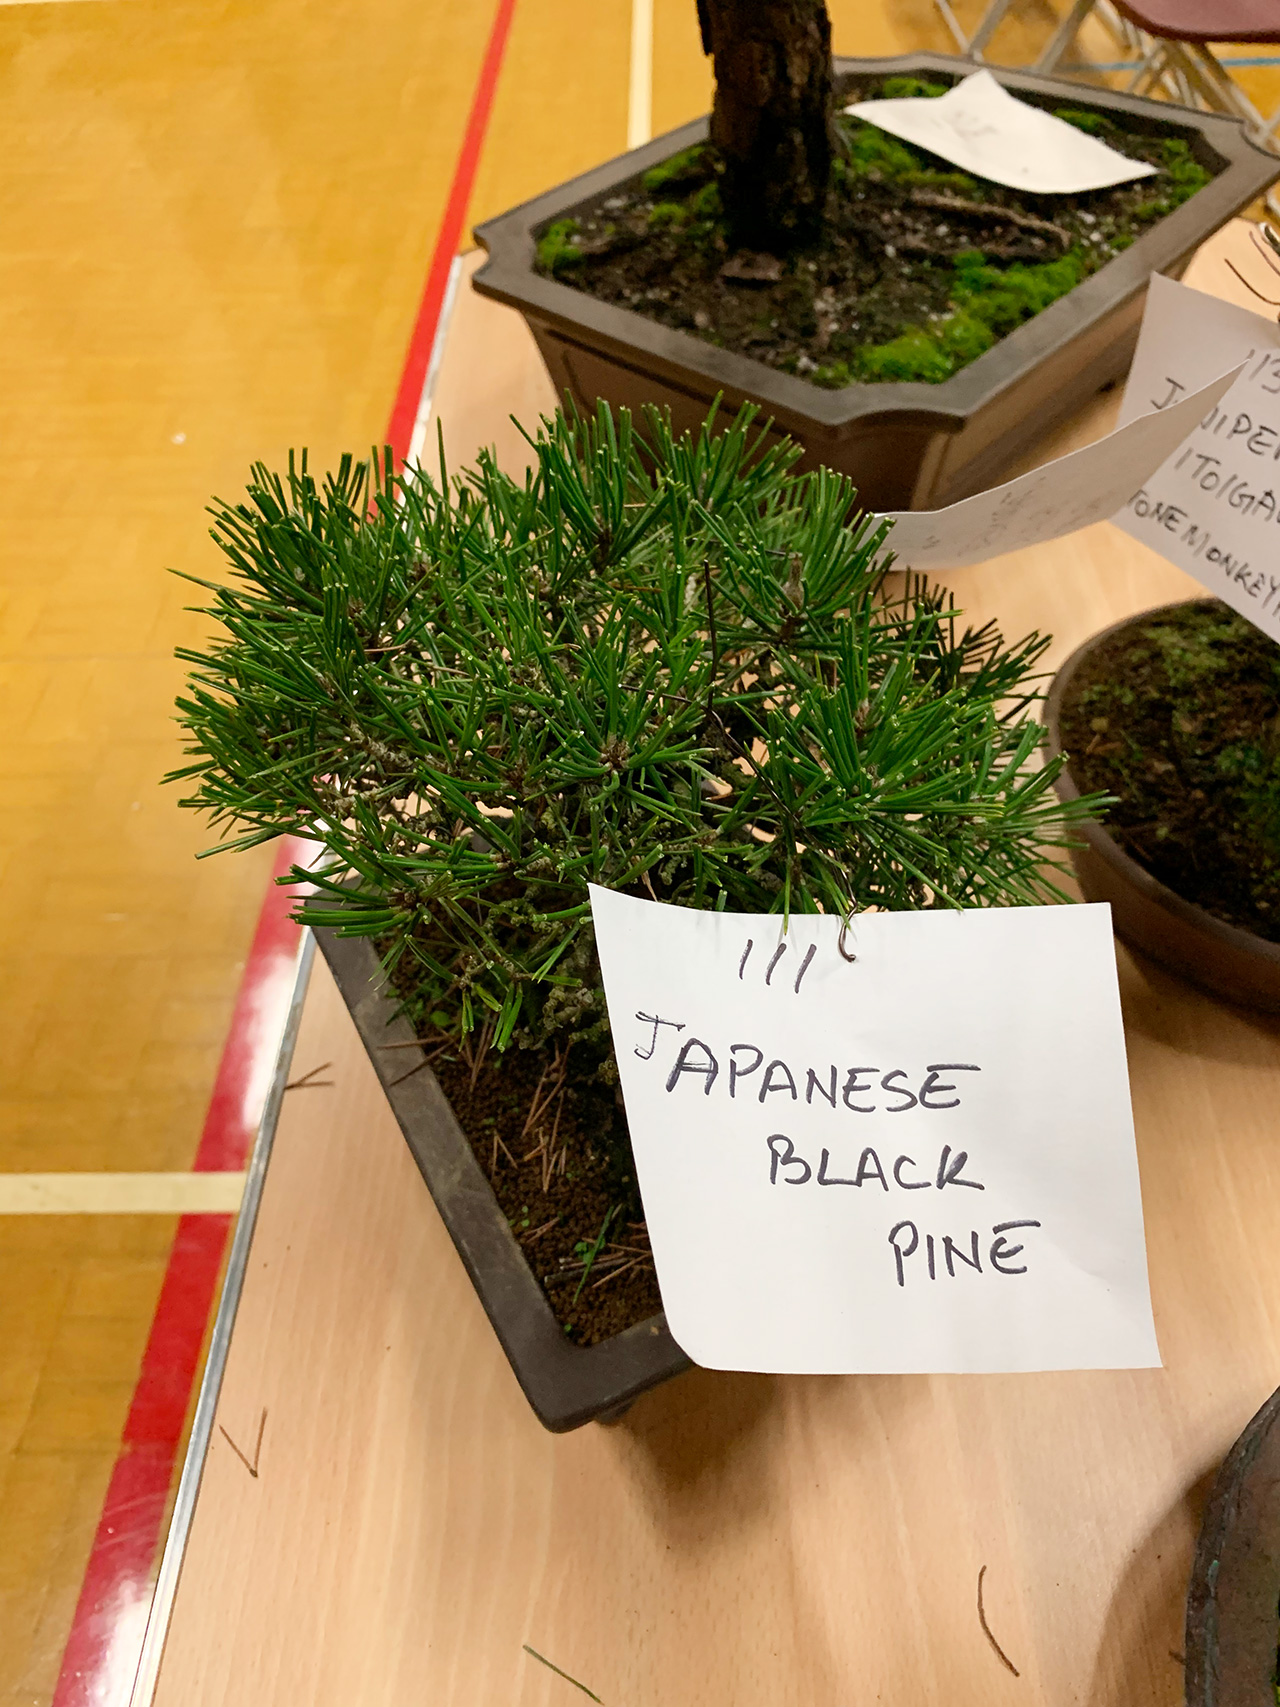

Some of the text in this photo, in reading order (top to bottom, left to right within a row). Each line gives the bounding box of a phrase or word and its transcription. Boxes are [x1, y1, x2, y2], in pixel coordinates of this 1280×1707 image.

[1173, 446, 1280, 523] ITOIGA
[634, 1010, 981, 1112] JAPANESE
[766, 1134, 985, 1191] BLACK
[888, 1220, 1041, 1287] PINE
